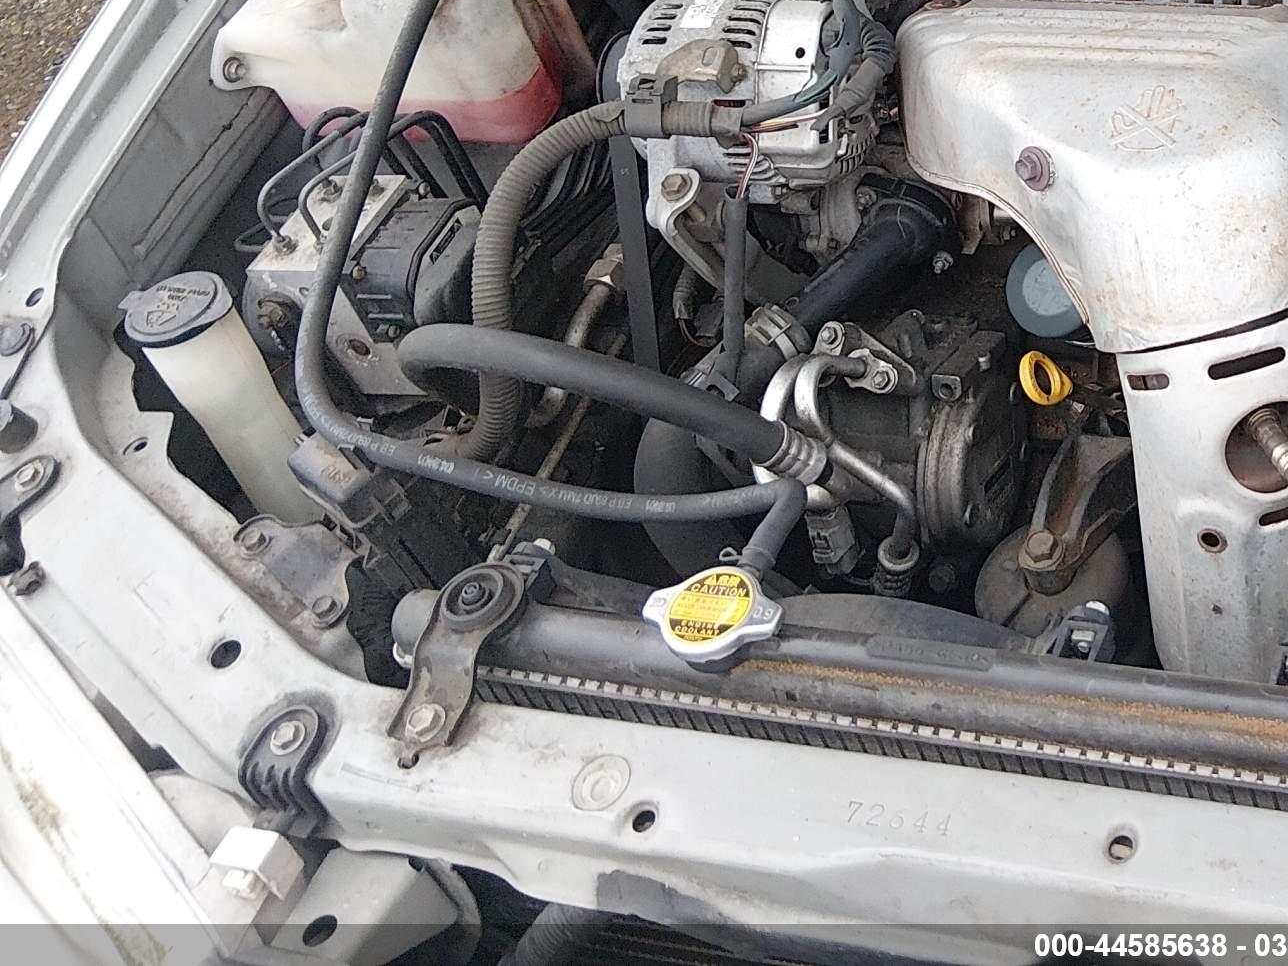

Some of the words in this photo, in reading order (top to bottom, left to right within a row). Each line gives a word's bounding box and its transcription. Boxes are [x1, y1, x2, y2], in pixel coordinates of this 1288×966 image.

[691, 584, 747, 597] CAUTION
[681, 619, 720, 629] ENGINE
[674, 626, 720, 637] COOLANT
